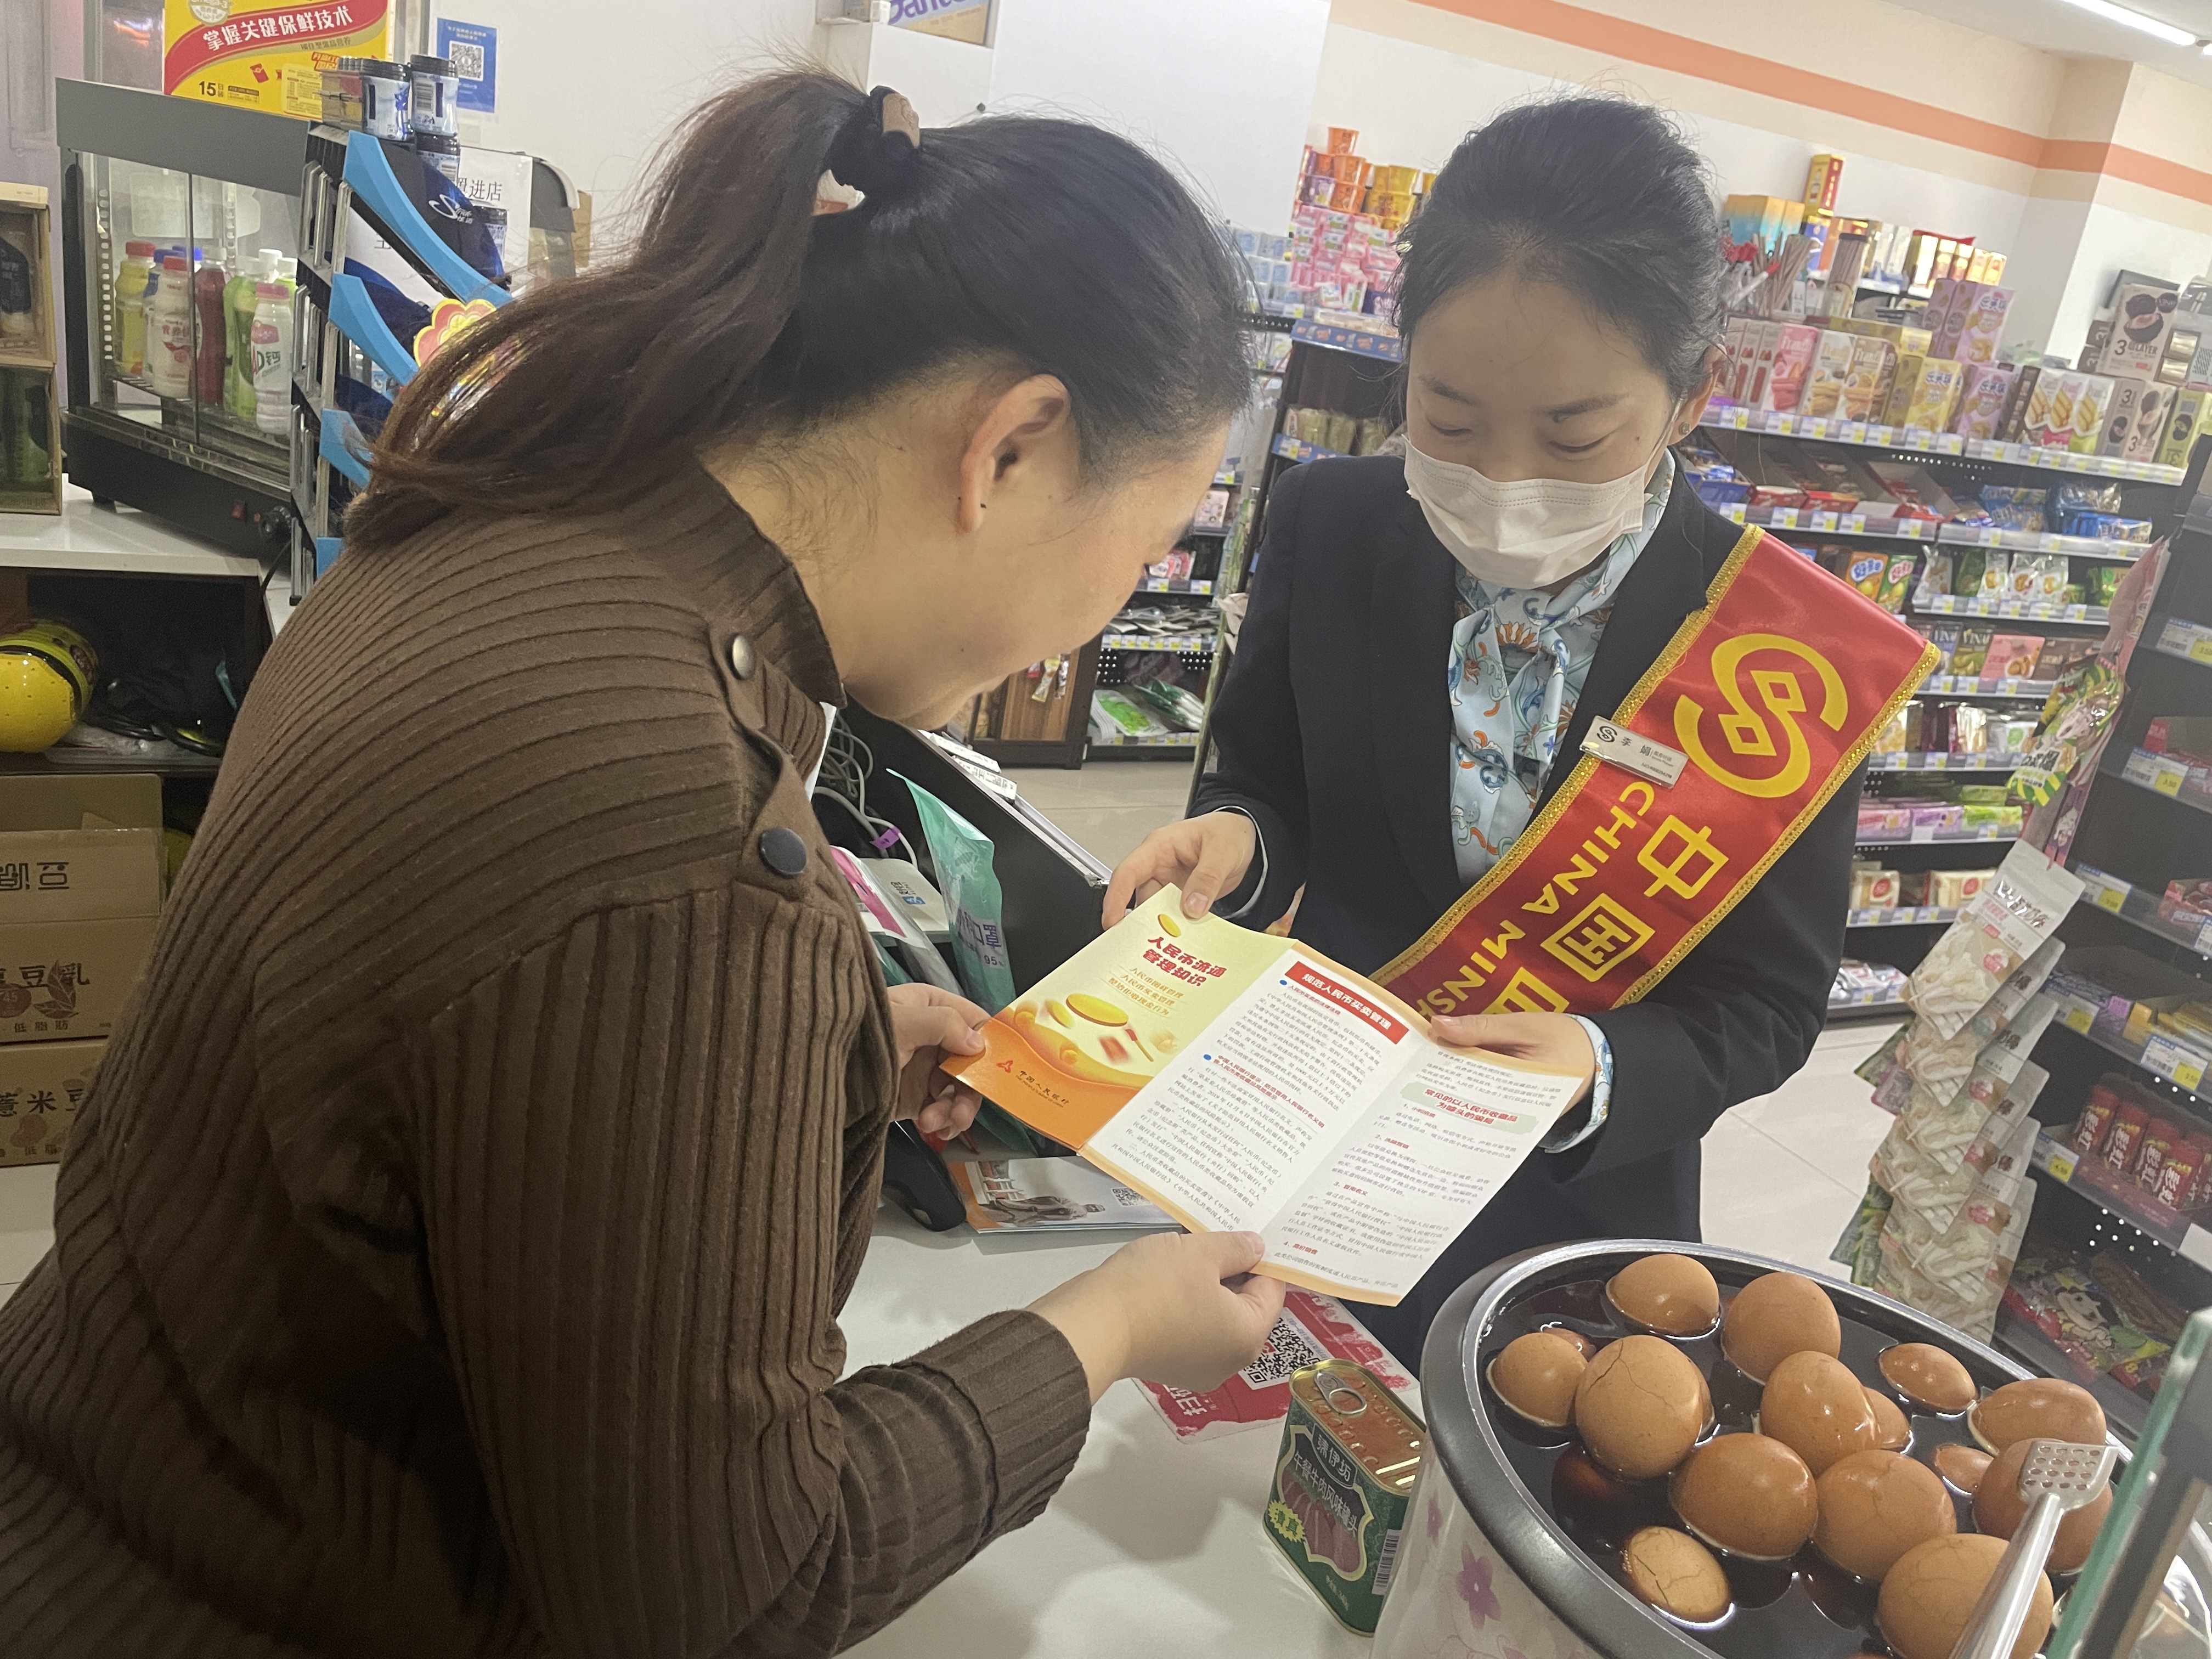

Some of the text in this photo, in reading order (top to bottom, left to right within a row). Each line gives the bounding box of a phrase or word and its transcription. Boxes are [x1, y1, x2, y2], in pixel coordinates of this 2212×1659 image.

[203, 5, 353, 52] 掌握关键保鲜技术
[199, 81, 216, 97] 15
[1521, 781, 1655, 915] CHINA
[1143, 949, 1207, 986] 管理知识
[1147, 936, 1227, 978] 人民币流通
[1108, 977, 1169, 1015] 整治拒收现金行为
[1301, 972, 1393, 1030] 规范人民币买卖管理
[1424, 1088, 1518, 1121] 常见的以人民币收藏品
[1436, 1101, 1494, 1124] 为噱头的骗局
